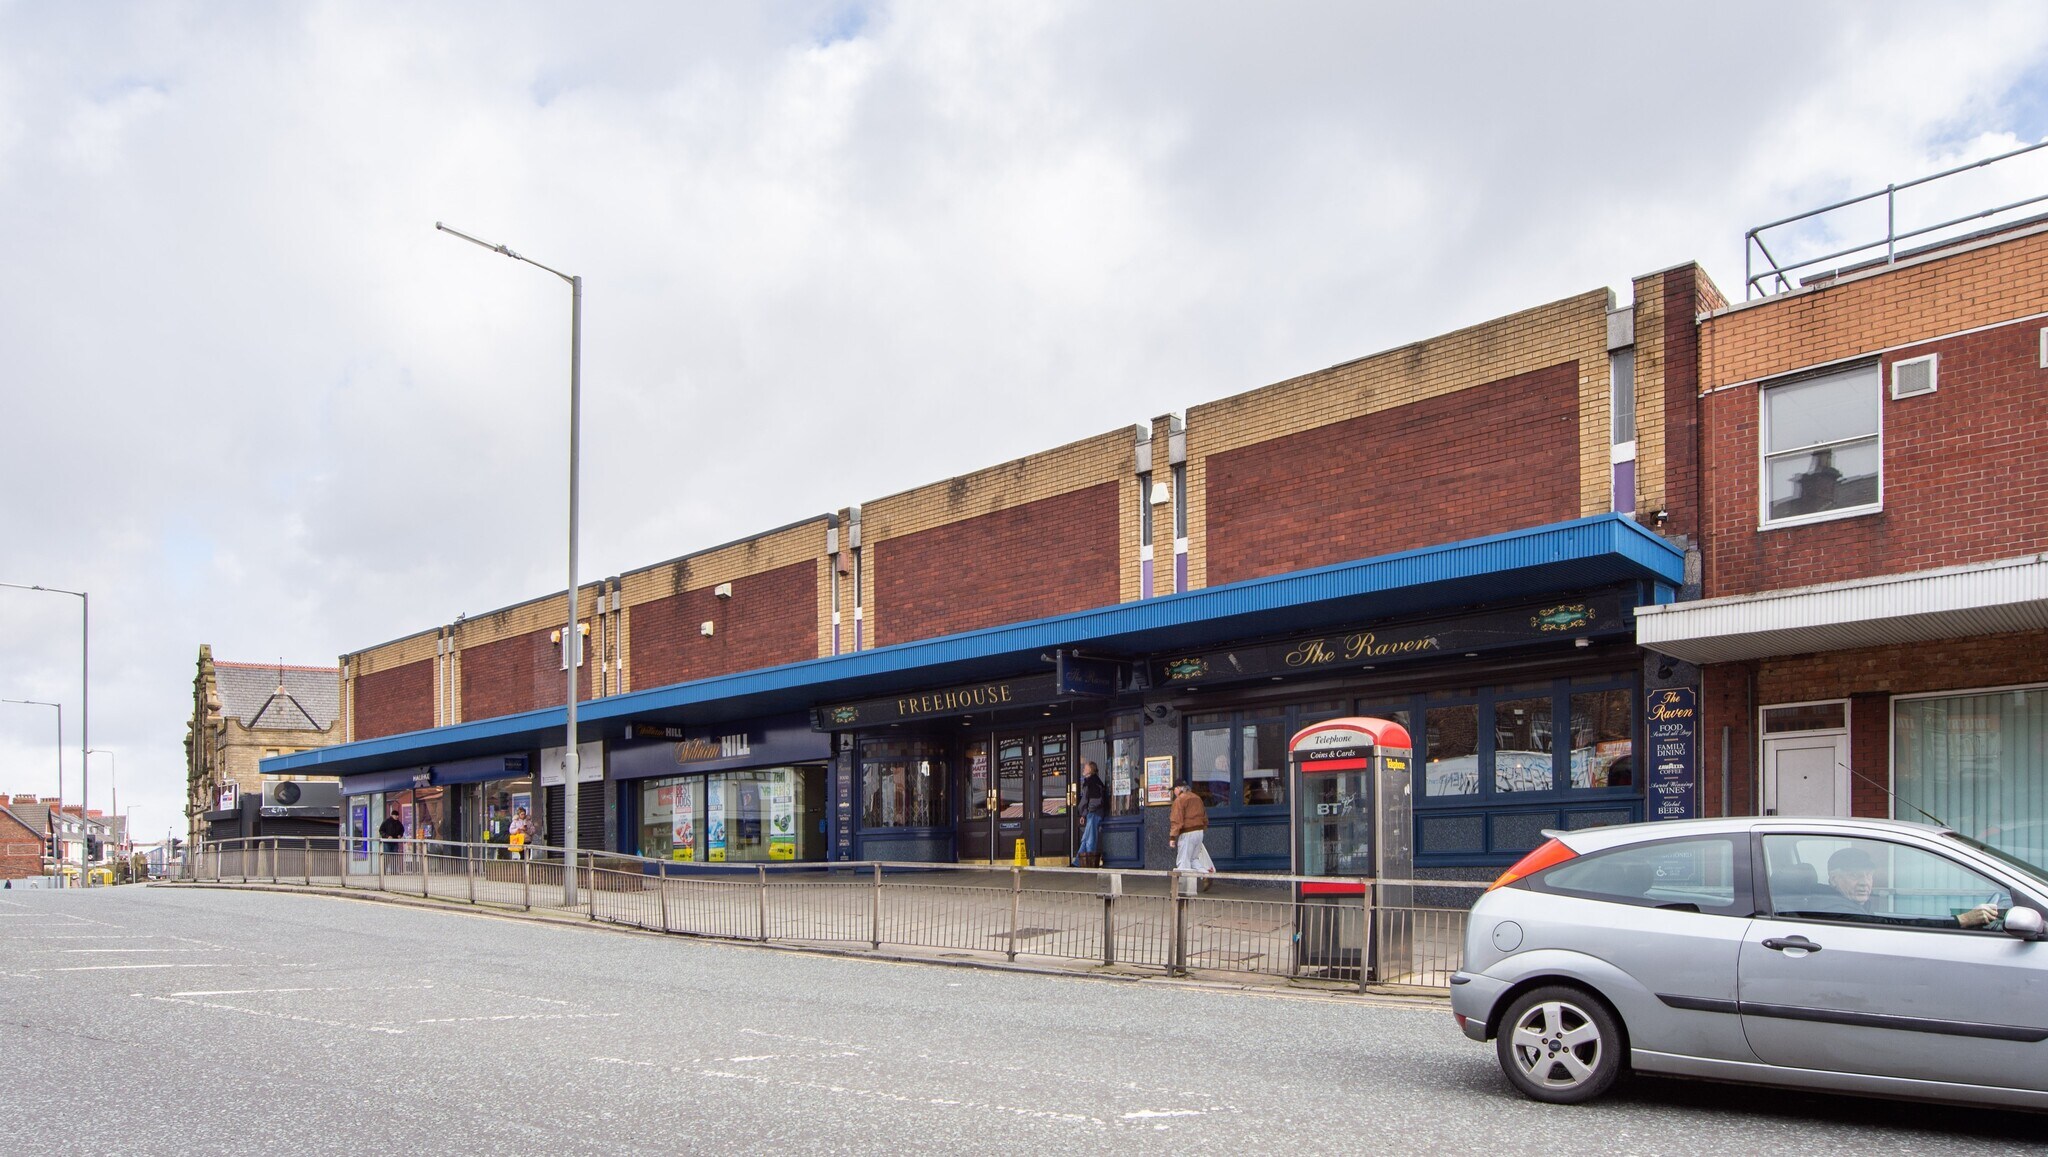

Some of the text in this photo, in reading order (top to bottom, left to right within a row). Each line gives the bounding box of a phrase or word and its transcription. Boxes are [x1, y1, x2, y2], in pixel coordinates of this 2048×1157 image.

[1286, 633, 1431, 667] The Raven
[898, 685, 1012, 715] FREEHOUSE
[1660, 691, 1680, 704] The
[1648, 704, 1693, 722] Raven
[666, 728, 682, 737] HILL
[1659, 724, 1683, 732] FOOD
[1315, 734, 1352, 745] Telephone
[675, 733, 750, 764] William HILL
[1657, 743, 1685, 751] FAMILY
[1310, 749, 1356, 759] Coins & Cards
[1657, 749, 1685, 757] DINING
[413, 772, 431, 782] HALIFAX
[1317, 803, 1342, 815] BT
[1658, 807, 1685, 815] BEERS
